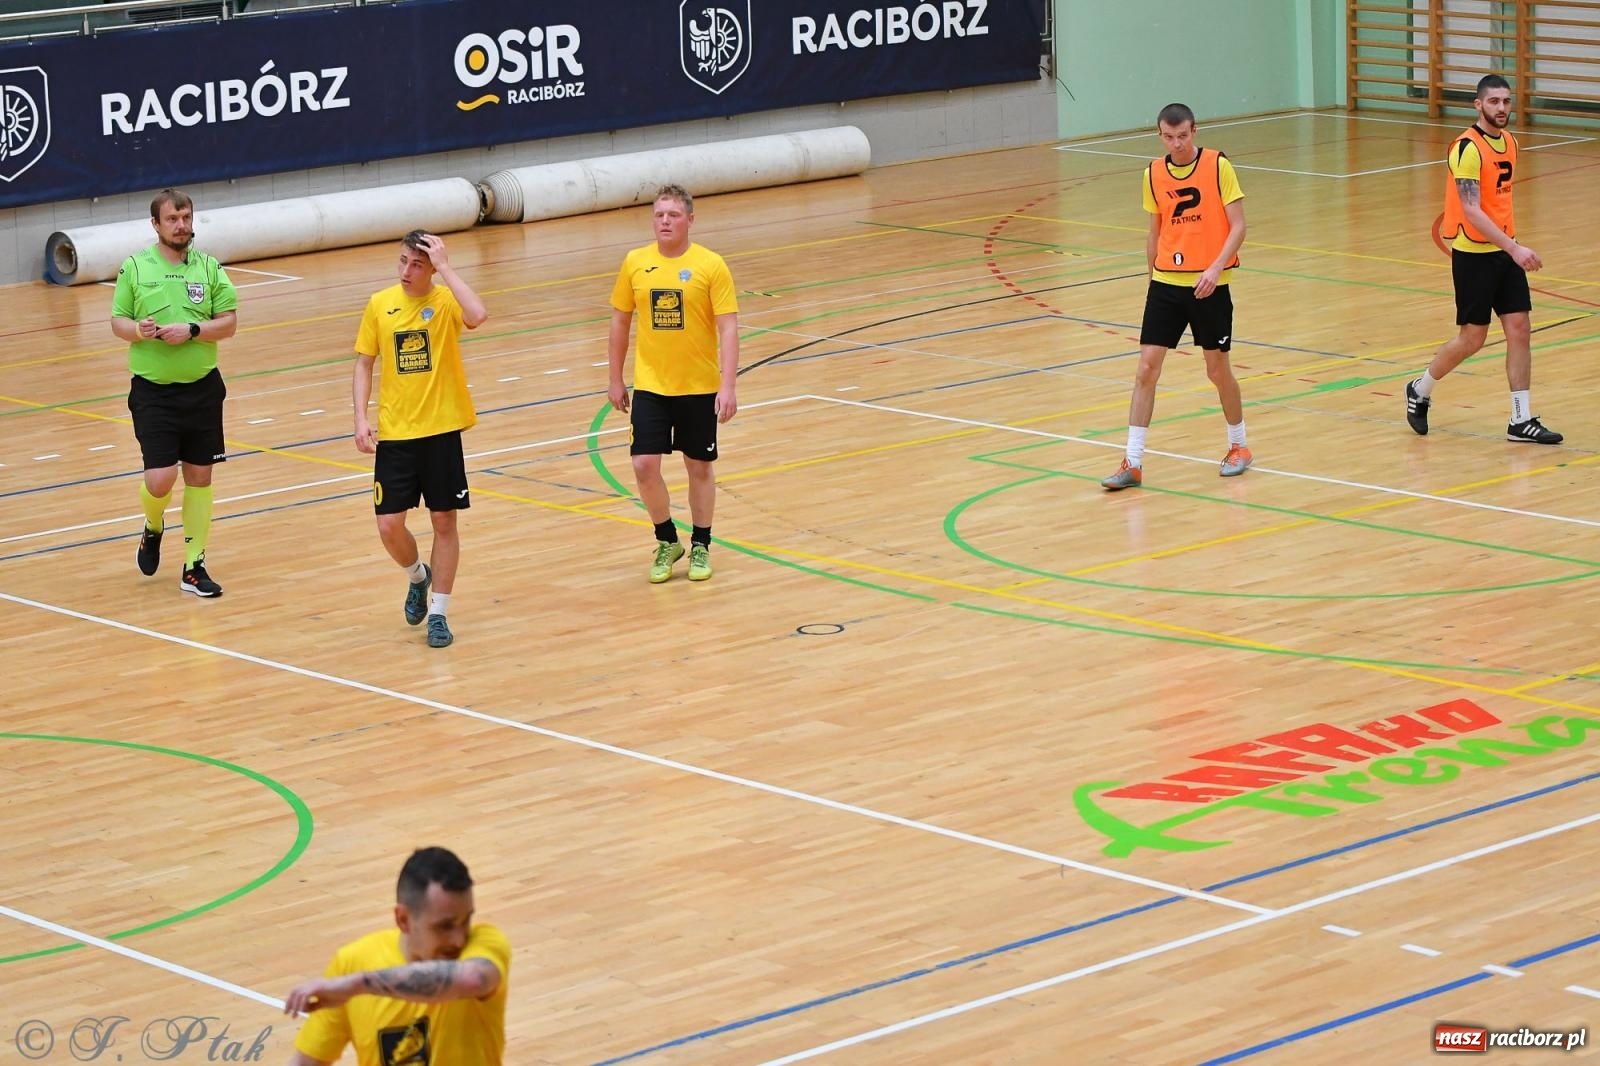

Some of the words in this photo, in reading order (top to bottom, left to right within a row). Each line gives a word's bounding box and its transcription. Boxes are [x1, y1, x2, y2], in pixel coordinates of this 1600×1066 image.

[792, 0, 989, 55] RACIBÓRZ
[454, 24, 584, 88] OSiR
[101, 59, 350, 136] RACIBÓRZ
[507, 80, 585, 105] RACIBÓRZ
[1171, 214, 1202, 226] PATRICK
